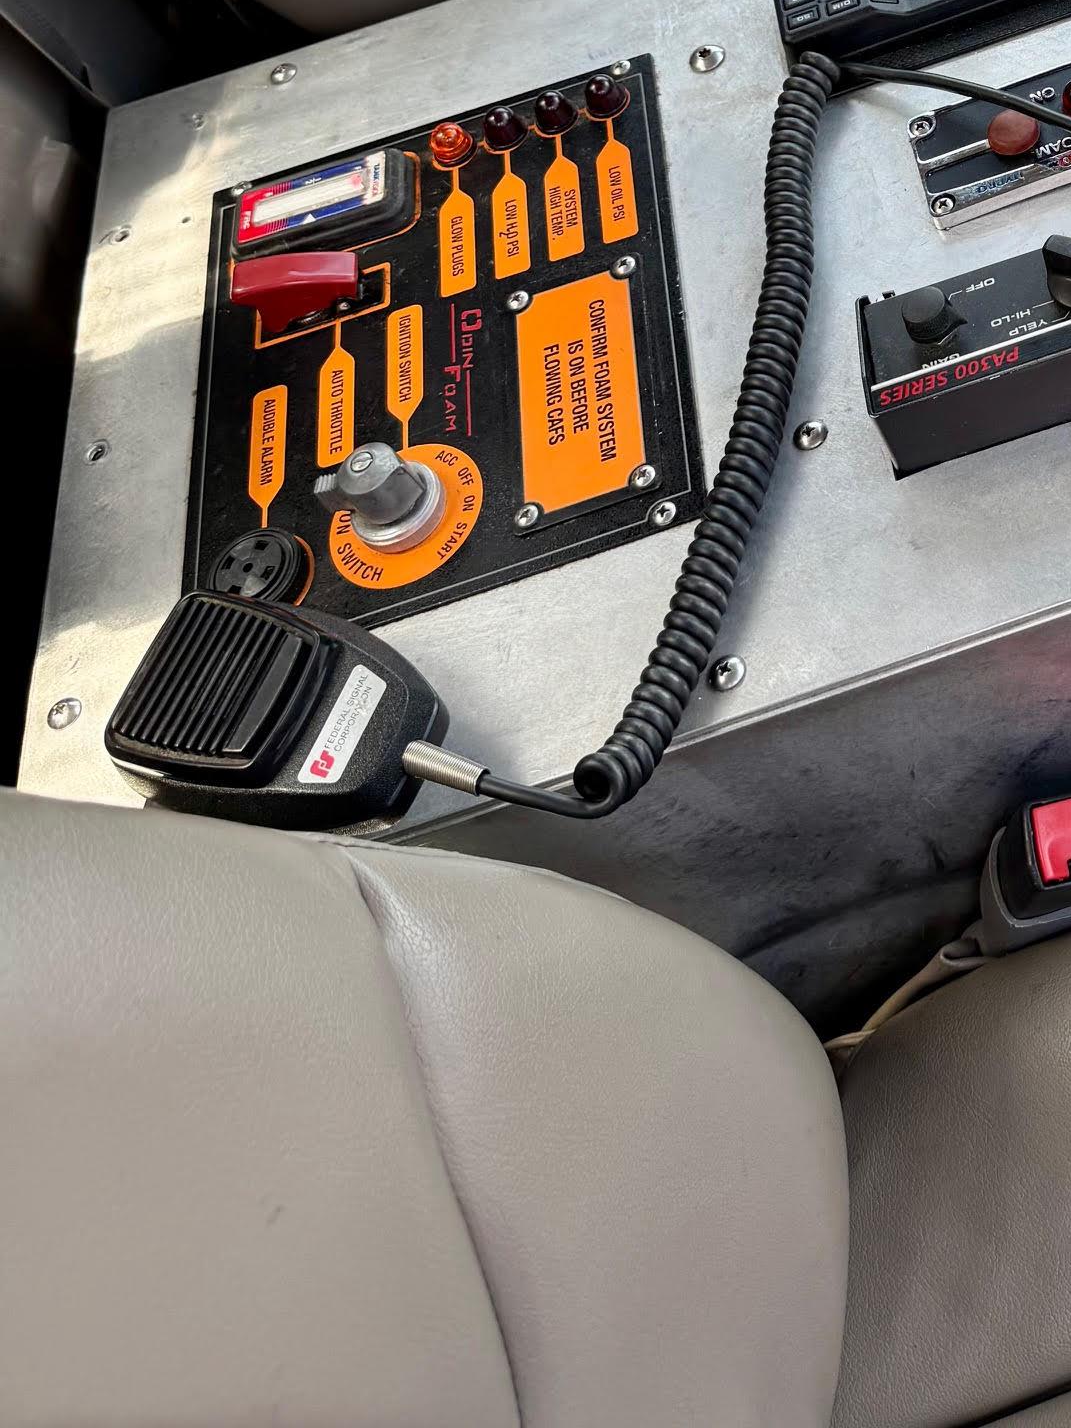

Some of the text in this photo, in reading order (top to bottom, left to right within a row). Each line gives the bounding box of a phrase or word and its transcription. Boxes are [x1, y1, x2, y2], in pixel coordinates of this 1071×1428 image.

[1029, 87, 1056, 105] ON
[505, 198, 517, 220] LOW
[549, 186, 561, 208] HIGH
[563, 188, 578, 228] SYSTEM
[608, 165, 625, 222] LOW OIL PSI
[450, 215, 464, 277] GLOW PLUGS
[507, 241, 520, 258] PSI
[966, 277, 995, 293] OFF
[991, 308, 1031, 328] HI-LO
[1009, 319, 1048, 337] YELP
[399, 315, 412, 403] IGNITION SWITCH
[880, 346, 1020, 406] PA300 SERIES
[921, 352, 960, 371] GAIN
[443, 364, 461, 433] FOAM
[544, 343, 566, 446] FLOWING CAFS
[568, 340, 590, 434] IS ON BEFORE
[589, 299, 617, 462] CONFIRM FOAM SYSTEM
[330, 369, 344, 455] AUTO THROTTLE
[259, 399, 276, 486] AUDIBLE ALARM
[435, 450, 459, 467] ACC
[457, 467, 474, 487] OFF
[462, 494, 475, 512] ON
[437, 521, 468, 561] START
[337, 542, 384, 582] SWITCH
[324, 674, 368, 749] FEDERAL SIGNAL
